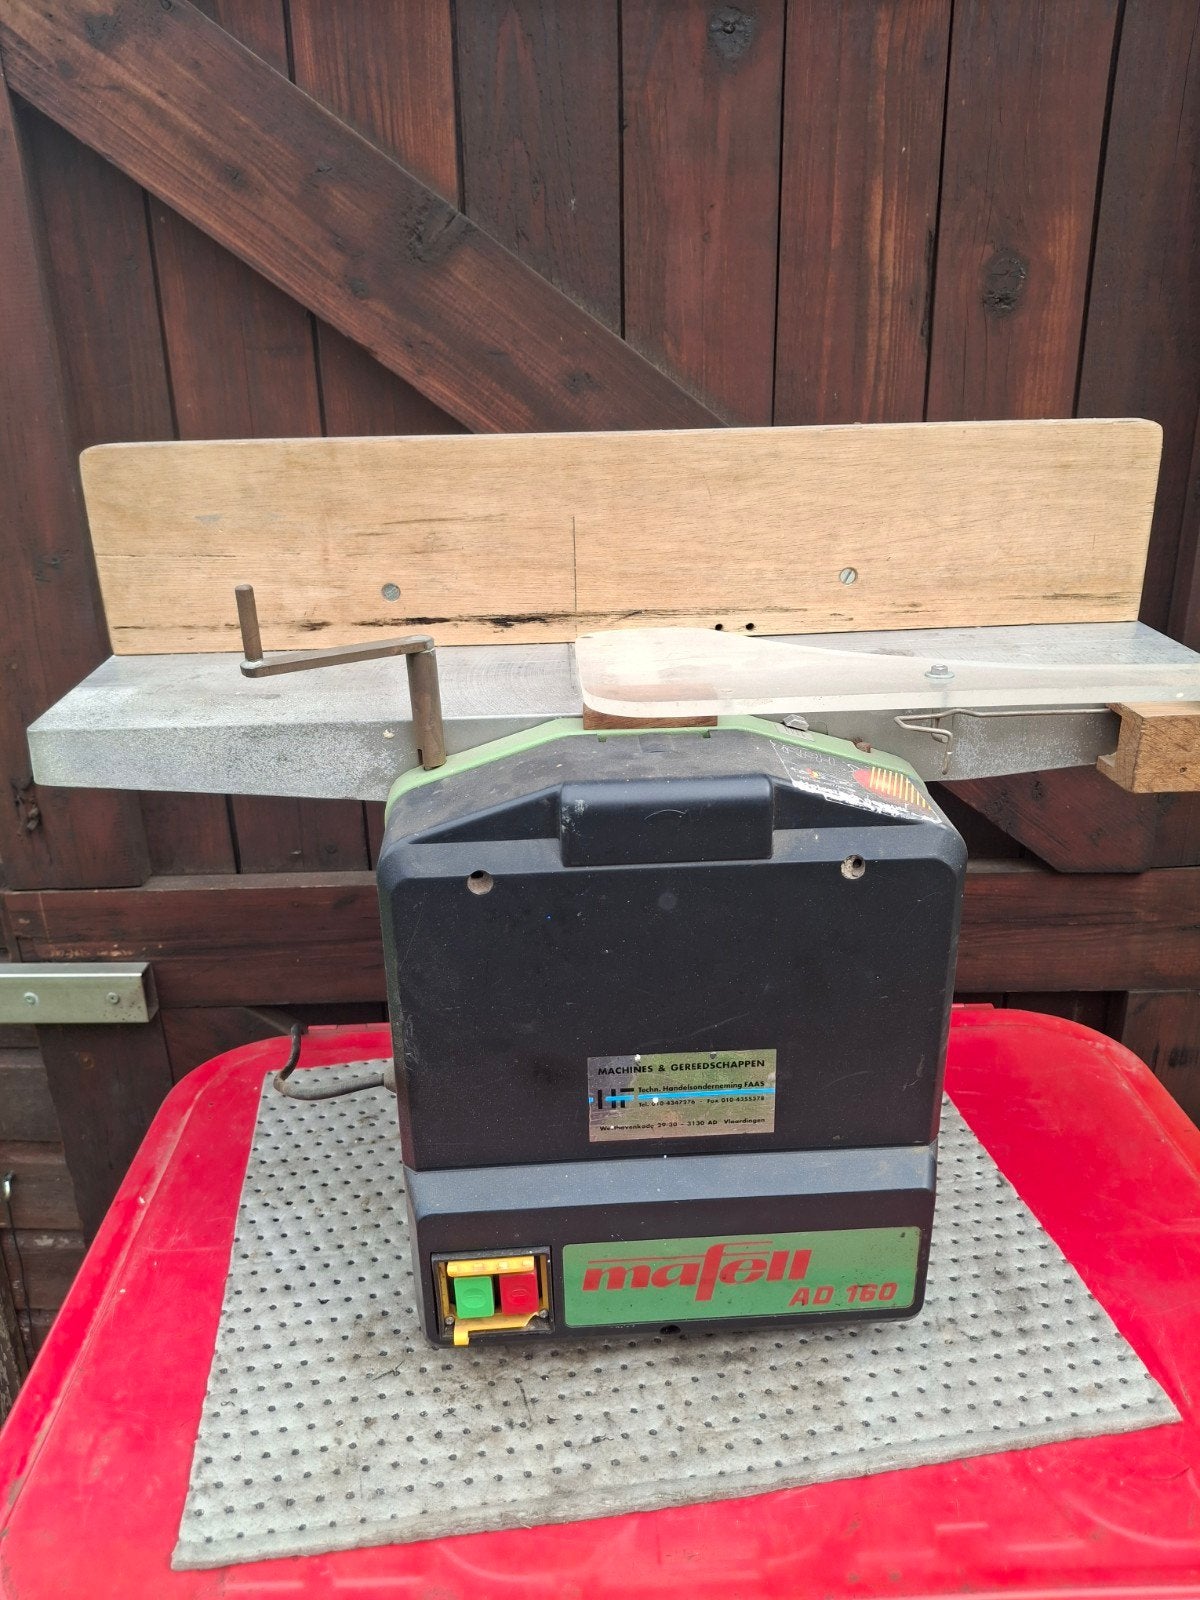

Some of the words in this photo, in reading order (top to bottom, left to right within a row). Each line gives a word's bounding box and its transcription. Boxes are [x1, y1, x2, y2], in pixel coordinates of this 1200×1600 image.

[597, 1065, 653, 1075] MACHINES
[658, 1064, 665, 1072] &
[670, 1060, 765, 1071] GEREEDSCHAPPEN
[663, 1082, 743, 1091] Handelsonderneming
[582, 1241, 812, 1302] mafell
[789, 1287, 834, 1307] AD
[846, 1283, 898, 1303] 160
